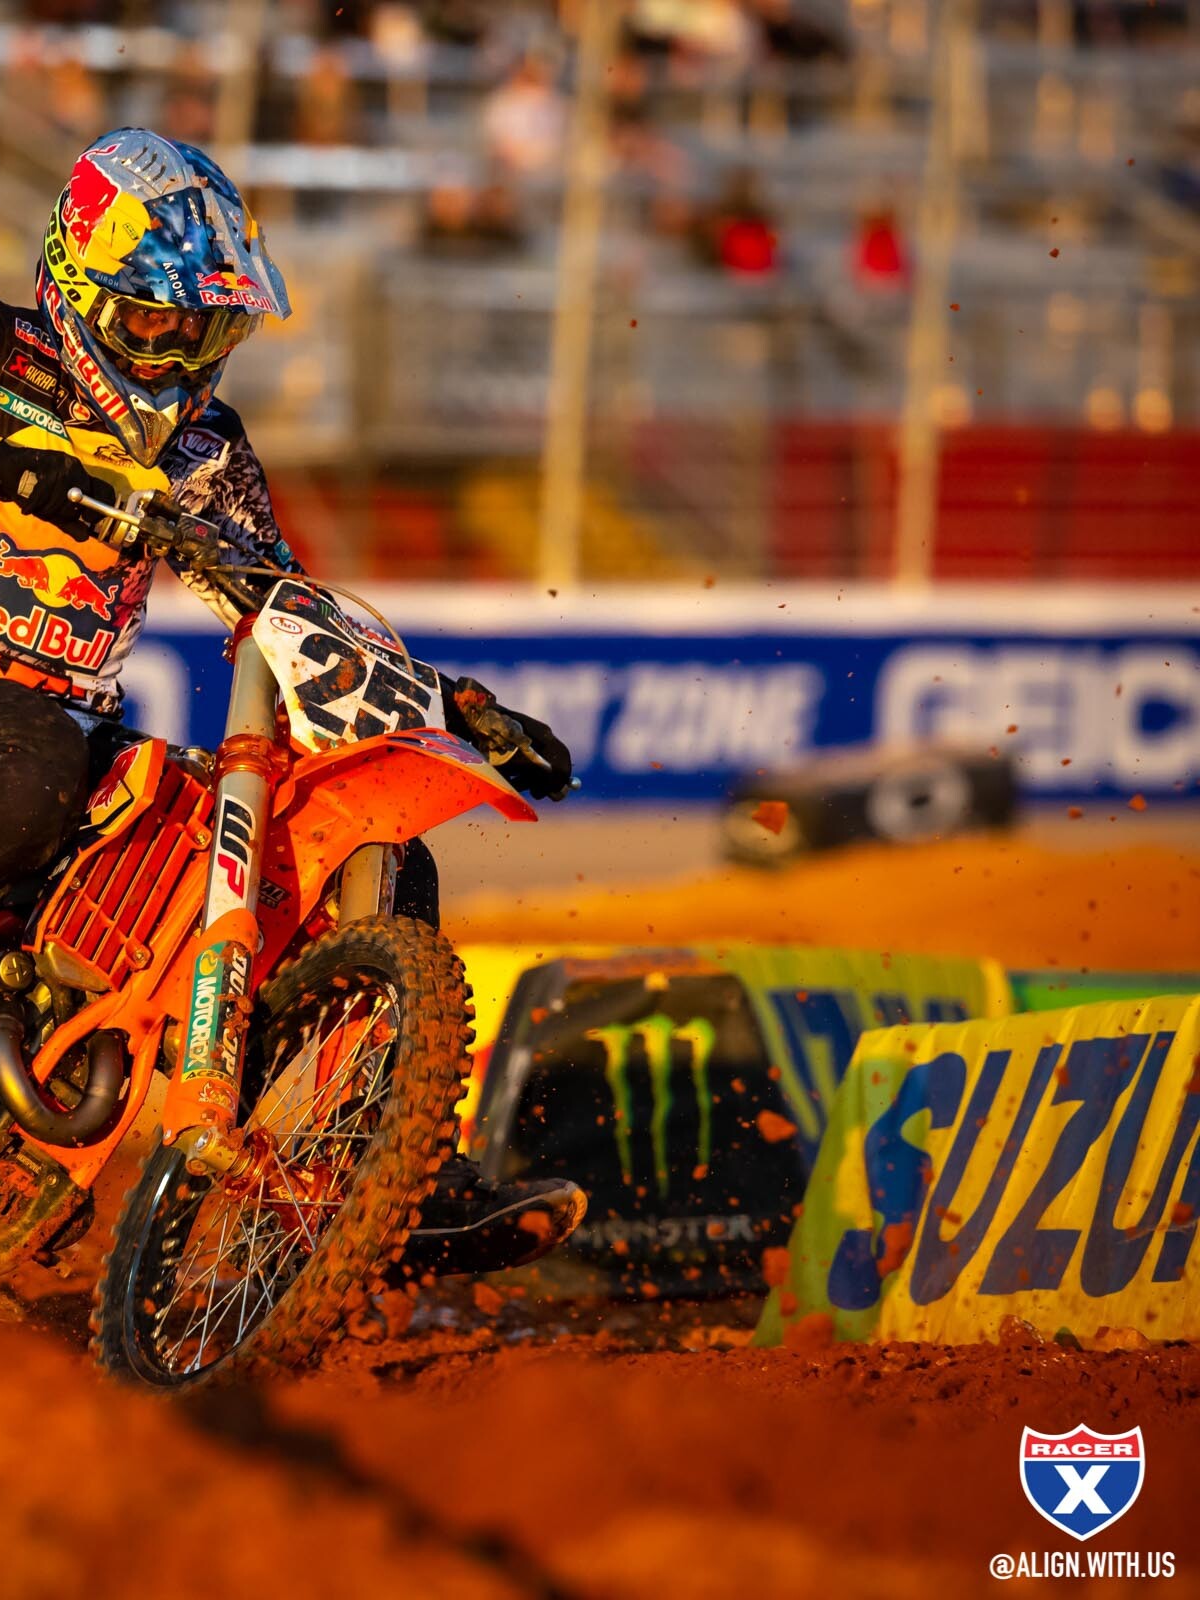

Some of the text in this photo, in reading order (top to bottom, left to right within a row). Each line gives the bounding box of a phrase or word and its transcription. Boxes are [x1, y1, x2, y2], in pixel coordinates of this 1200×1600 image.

[95, 273, 119, 287] AIROH
[162, 261, 187, 299] AIROH
[201, 290, 273, 311] Red Bull
[76, 351, 129, 422] Bull
[186, 432, 222, 459] 100%
[37, 613, 115, 671] Bull
[294, 632, 432, 742] 25
[876, 643, 1200, 788] GEIC
[218, 797, 256, 899] WP
[187, 976, 217, 1069] MOTOREX
[223, 947, 248, 1076] DUOP
